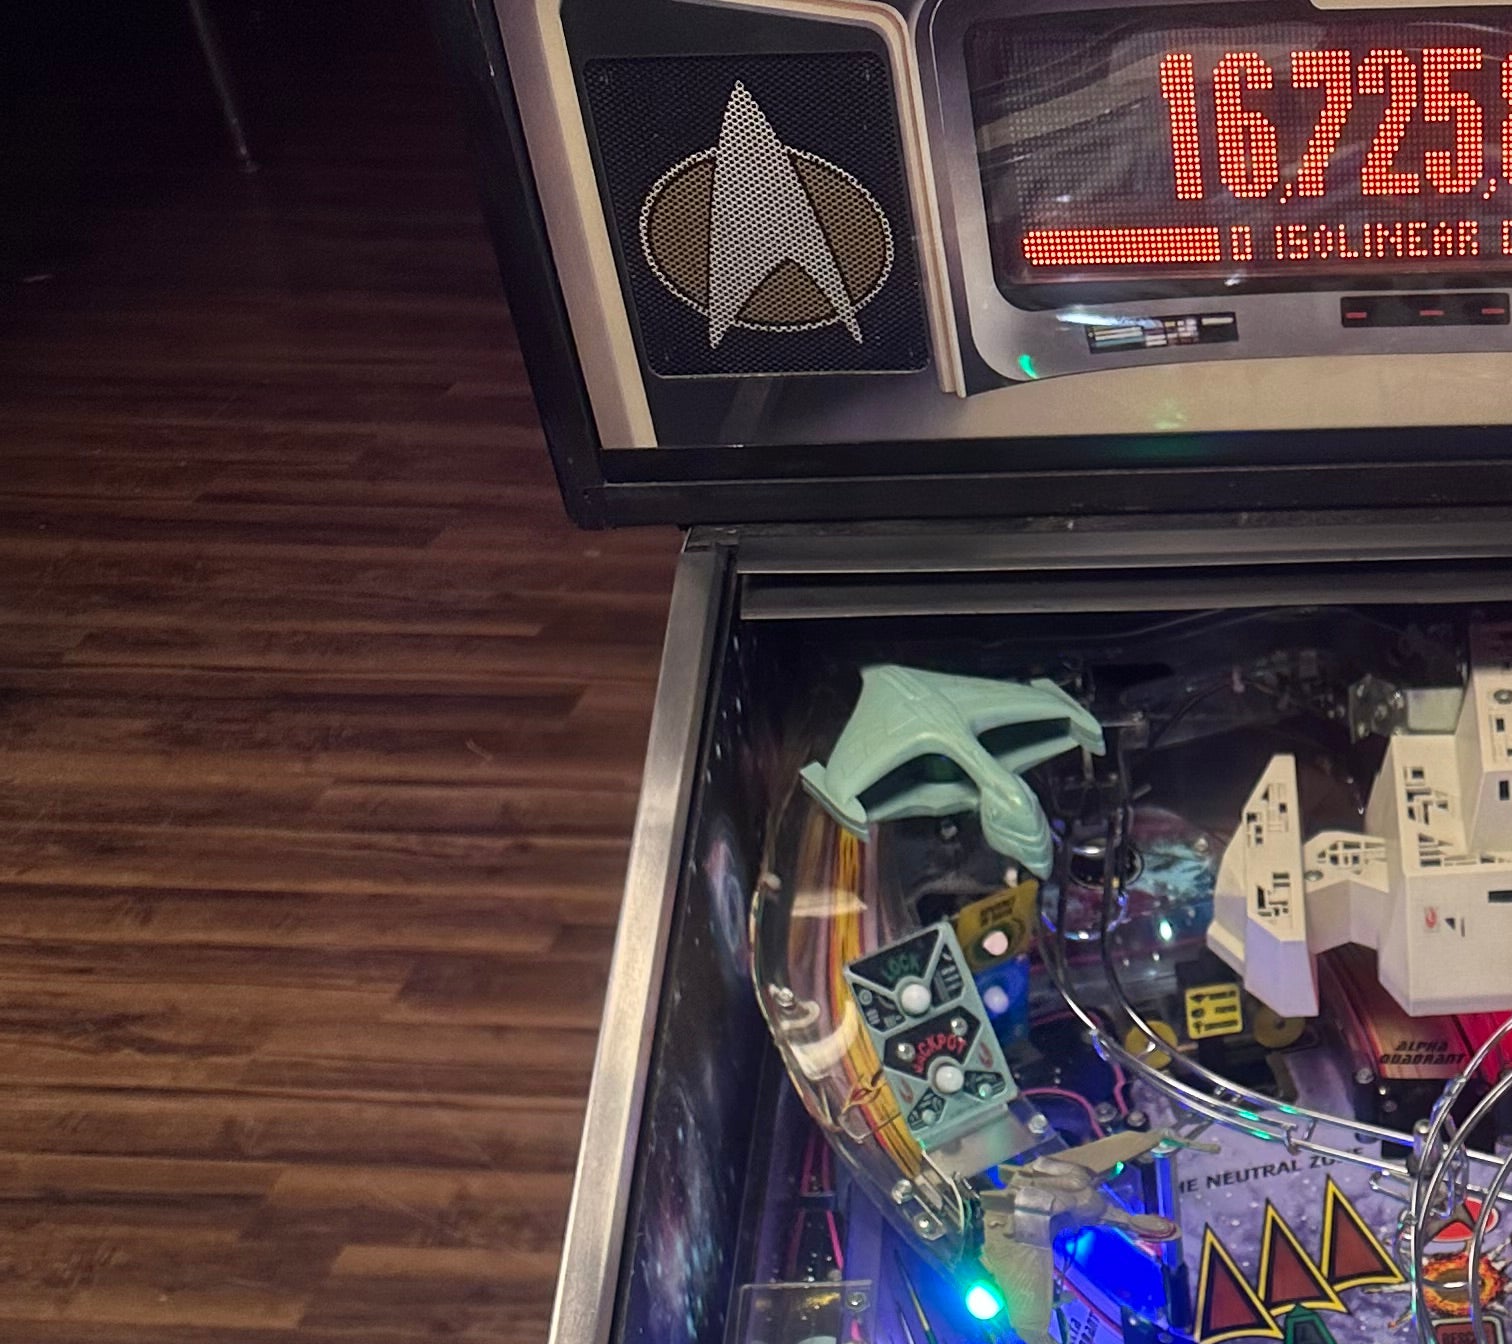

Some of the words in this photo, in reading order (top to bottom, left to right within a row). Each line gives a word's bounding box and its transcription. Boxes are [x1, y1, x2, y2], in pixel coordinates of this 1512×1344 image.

[1275, 220, 1481, 261] ISOLINEAR
[1395, 1041, 1448, 1051] ALPHA
[1380, 1053, 1466, 1064] QUADRANT
[1206, 1154, 1300, 1188] NEUTRAL
